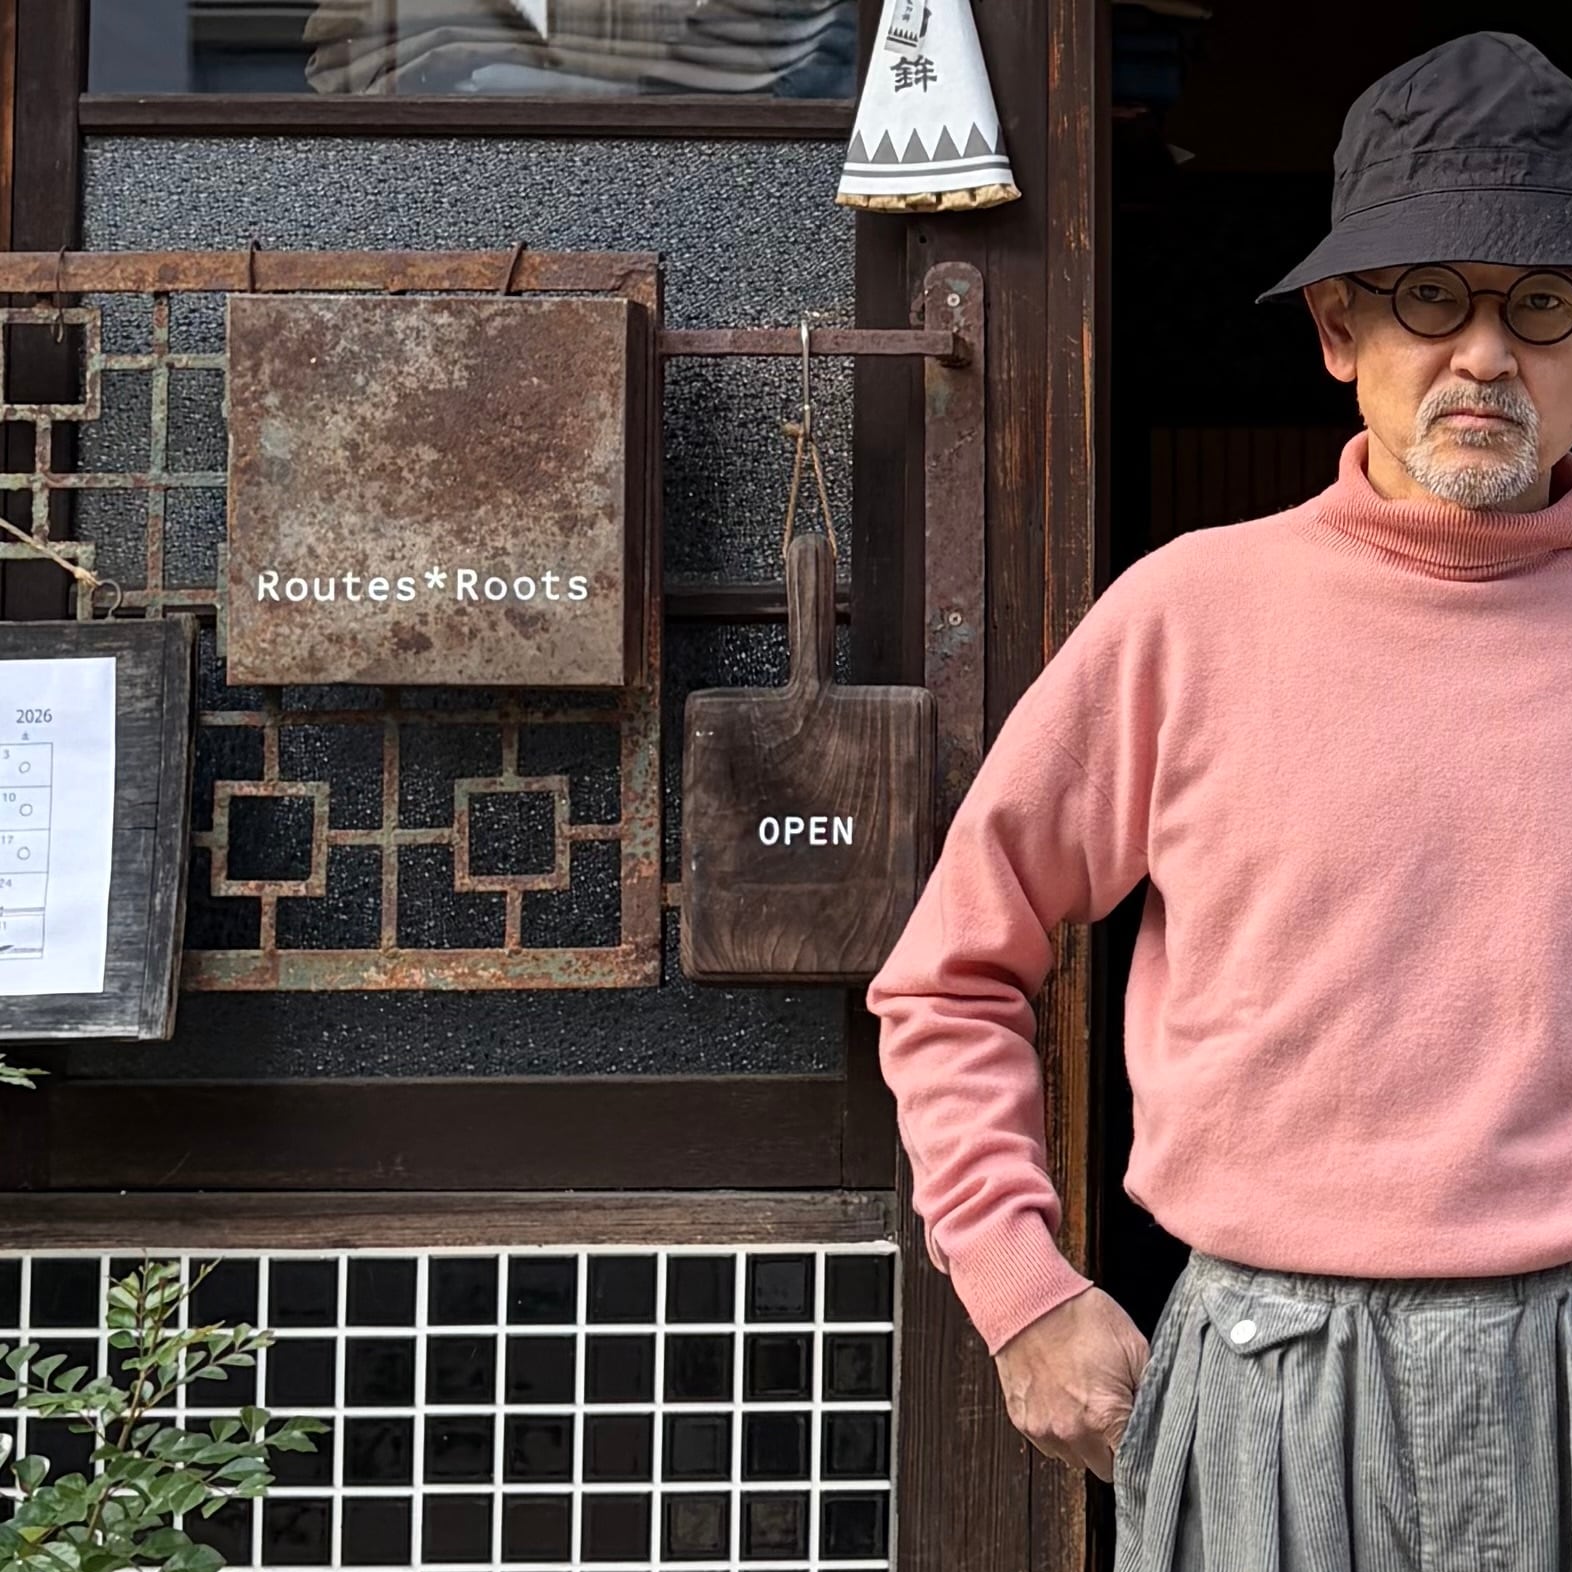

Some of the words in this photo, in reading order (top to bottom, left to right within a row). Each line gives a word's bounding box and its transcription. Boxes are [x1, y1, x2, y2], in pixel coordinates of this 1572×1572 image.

[15, 708, 53, 724] 2026
[2, 792, 17, 803] 10
[758, 816, 854, 846] OPEN
[1, 834, 14, 845] 17
